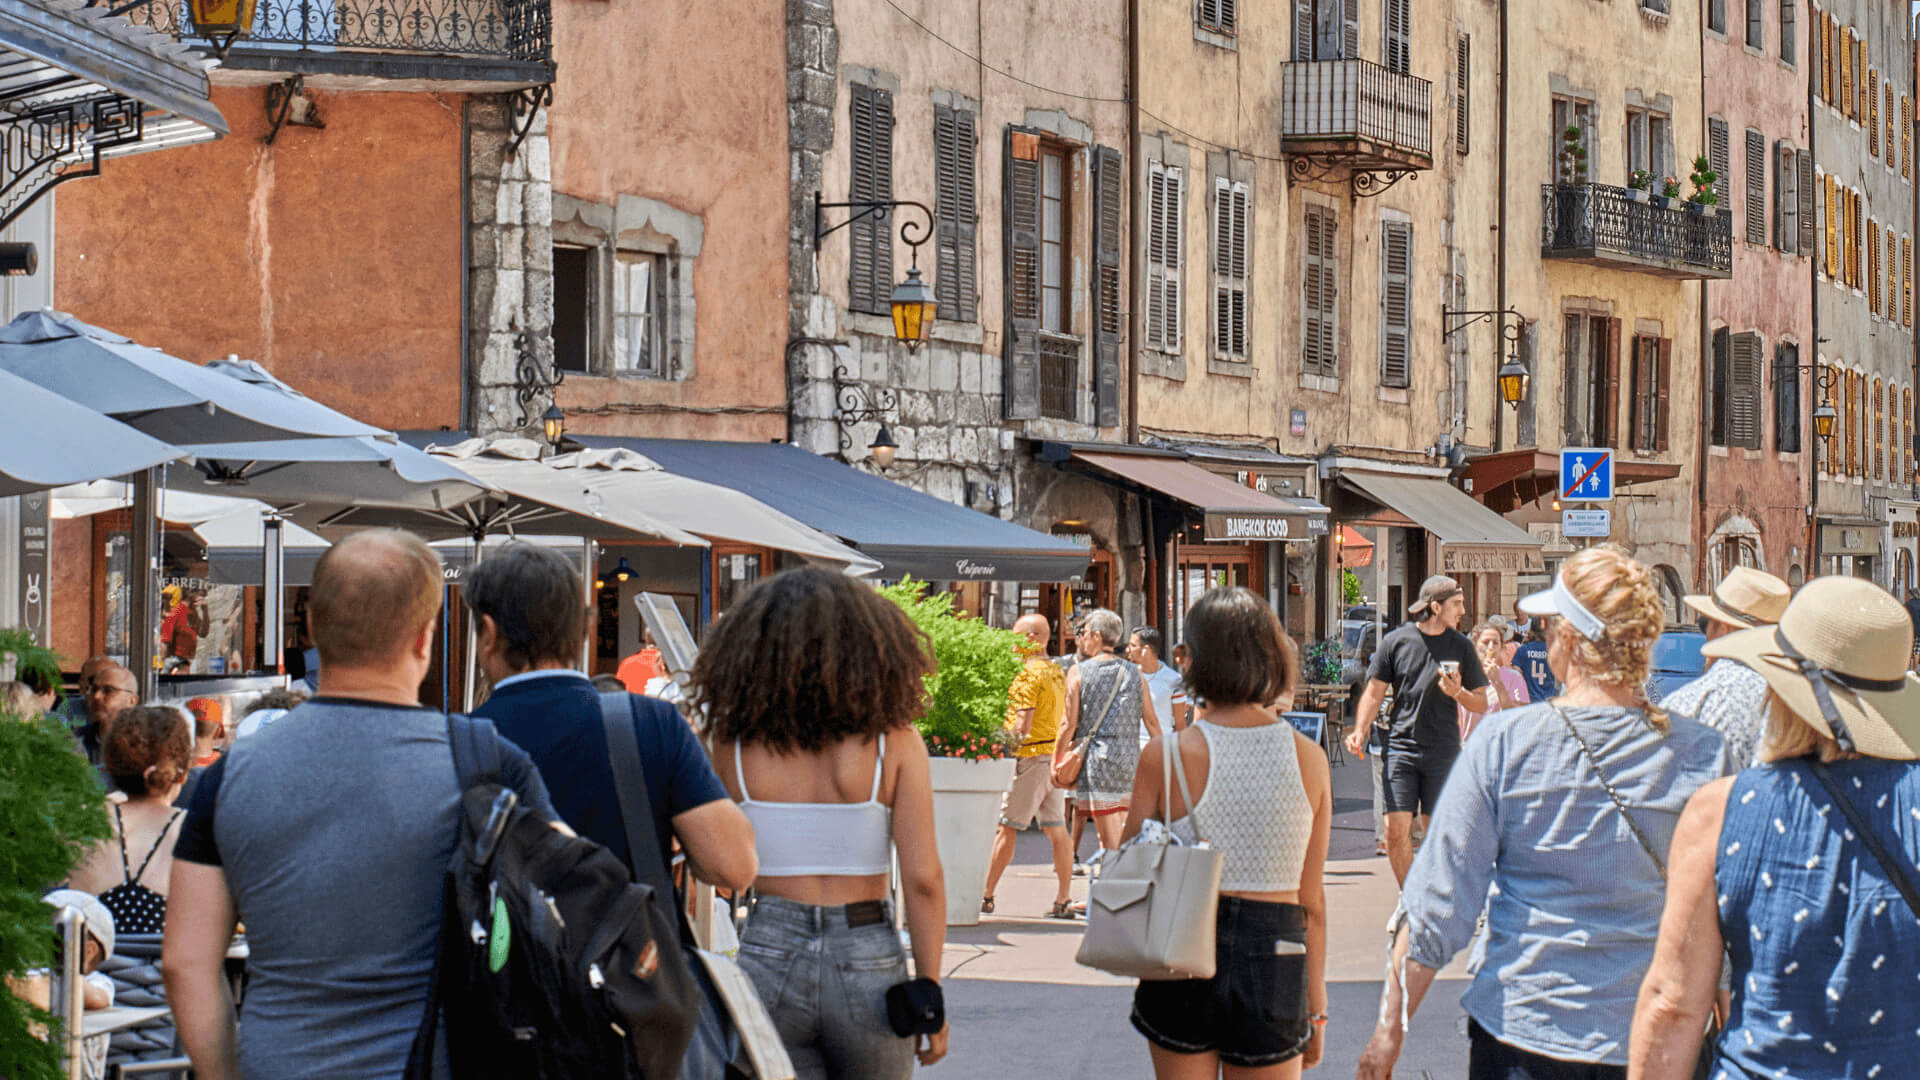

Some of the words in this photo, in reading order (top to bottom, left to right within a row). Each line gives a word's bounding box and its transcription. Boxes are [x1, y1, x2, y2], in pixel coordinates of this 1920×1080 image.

[1226, 518, 1266, 537] BANGKOK
[1266, 518, 1289, 537] FOOD
[955, 559, 996, 578] Crêperie
[1531, 660, 1547, 685] 4
